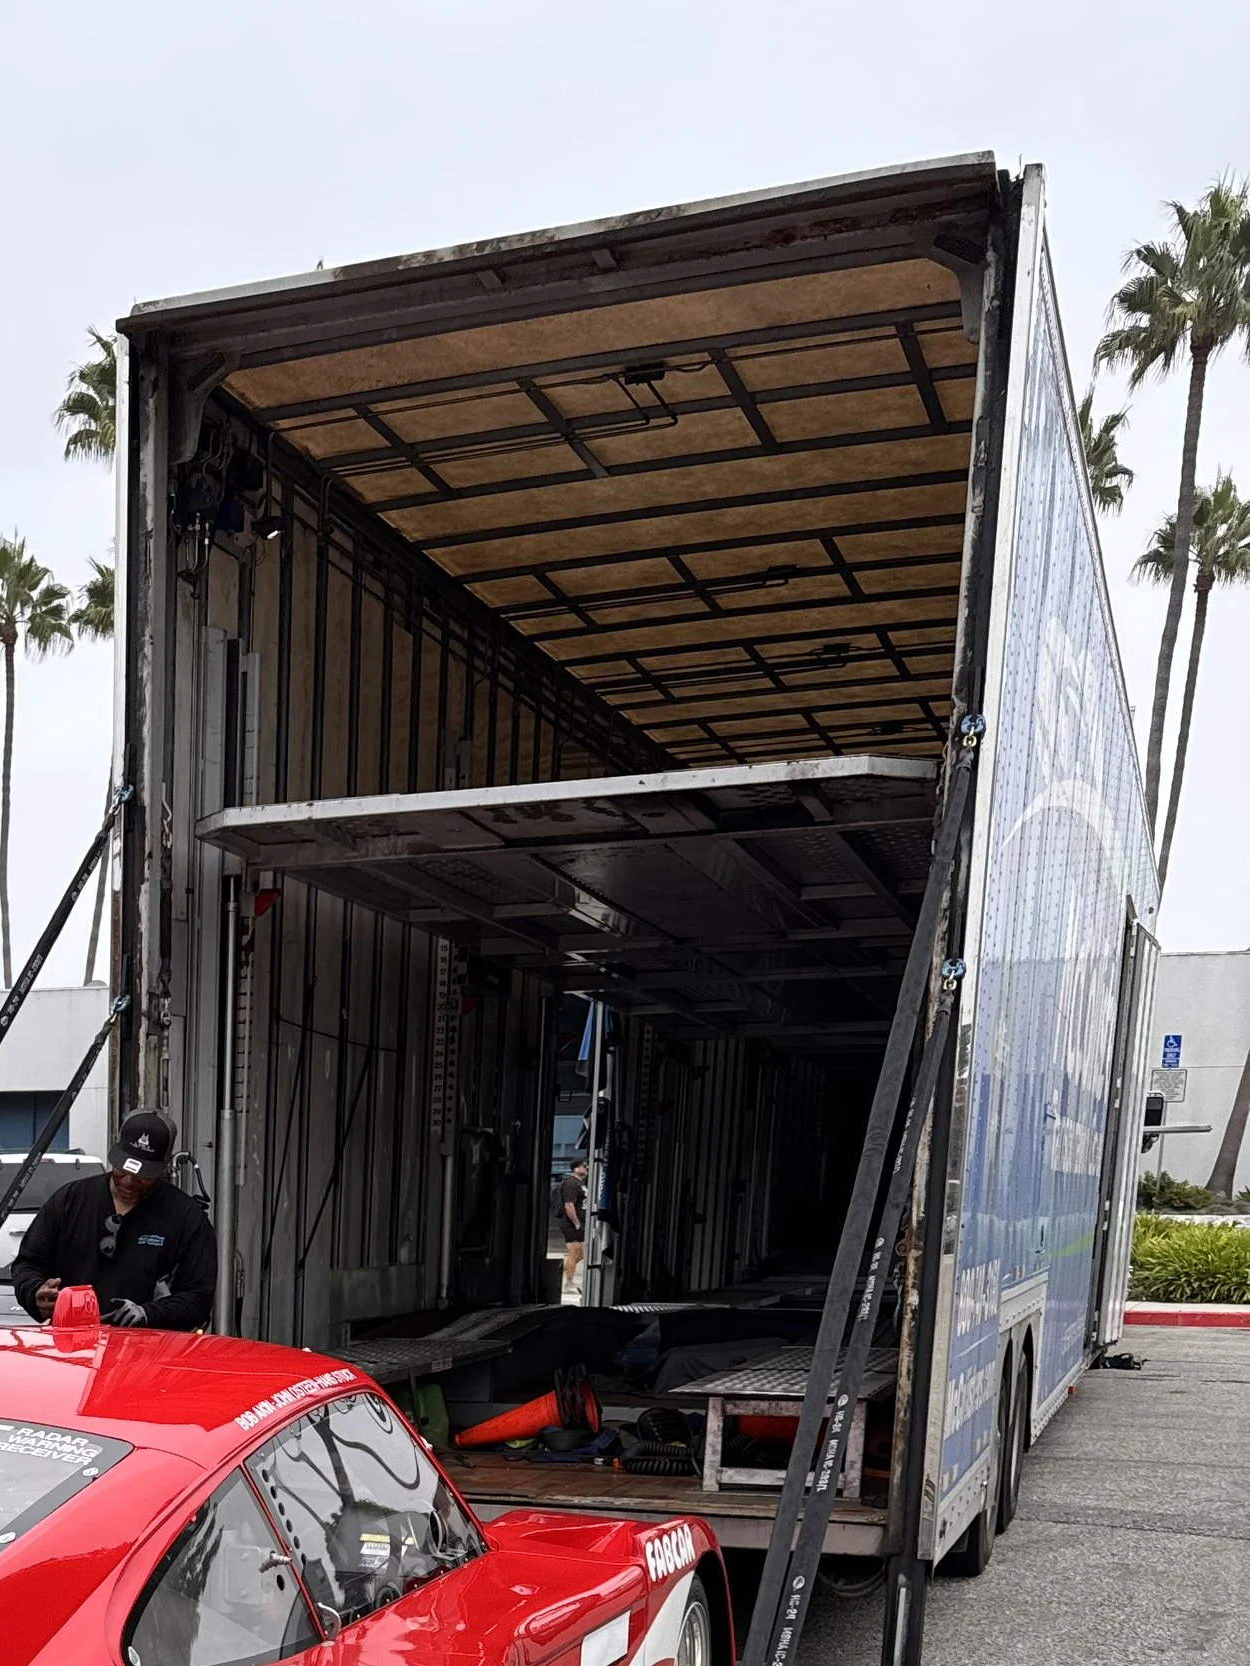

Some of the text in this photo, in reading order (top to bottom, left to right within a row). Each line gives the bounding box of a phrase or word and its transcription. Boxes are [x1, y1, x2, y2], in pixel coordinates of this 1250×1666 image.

[234, 1410, 259, 1431] BOB
[8, 1435, 99, 1458] WARNING
[16, 1428, 89, 1447] RADAR
[646, 1524, 695, 1583] FABCAR
